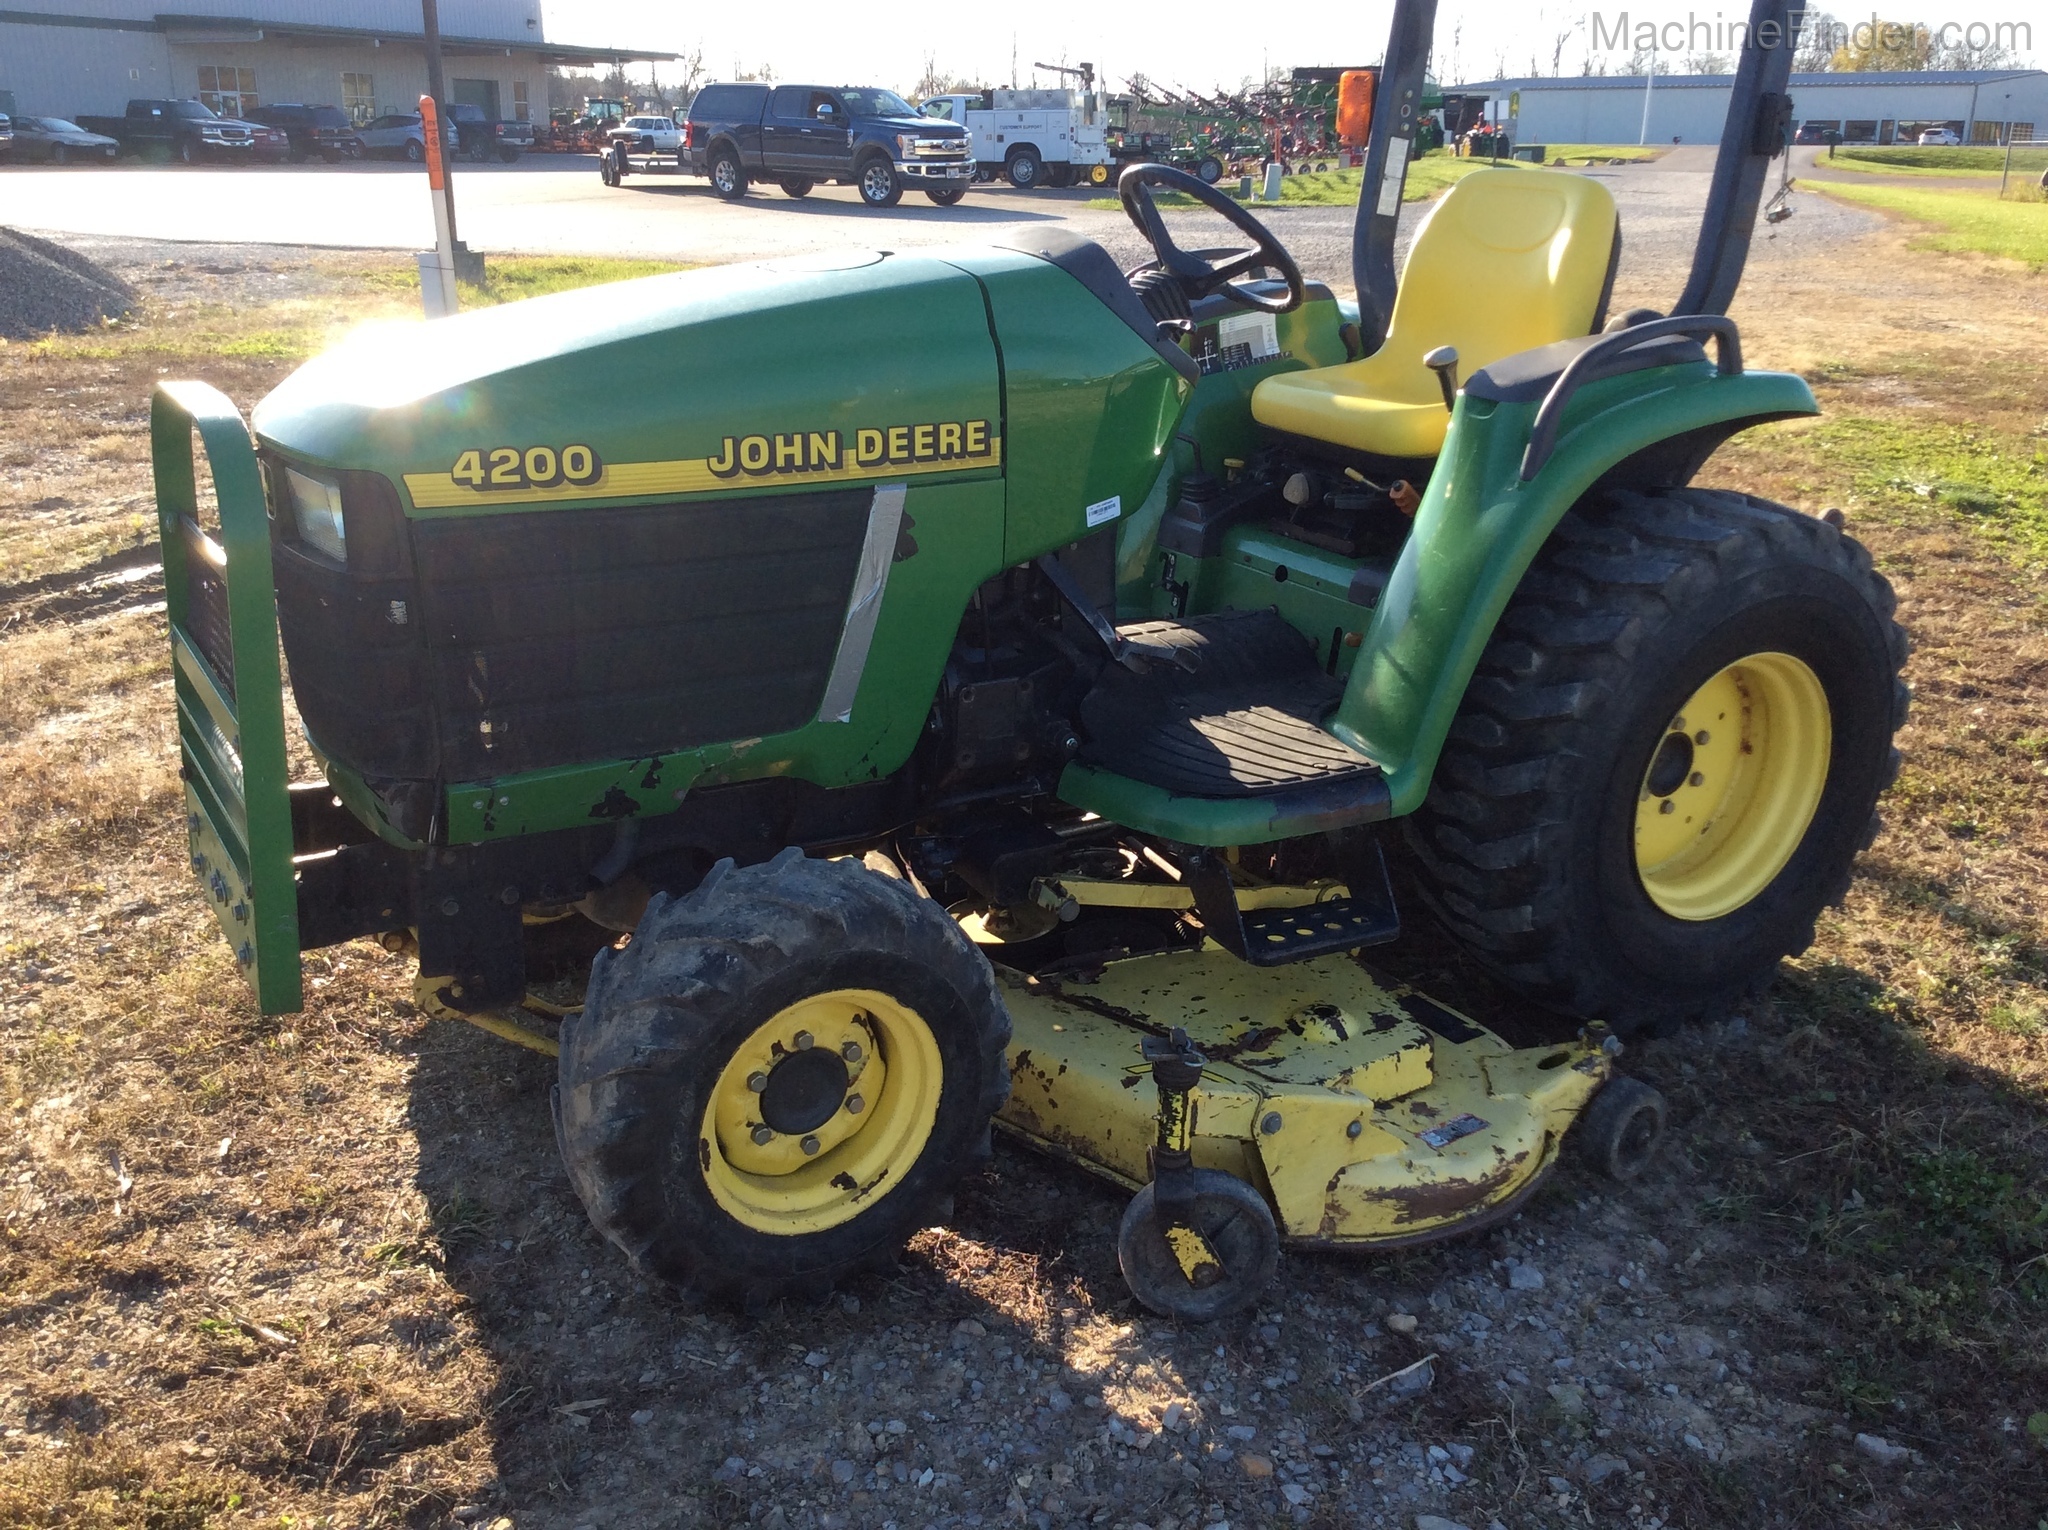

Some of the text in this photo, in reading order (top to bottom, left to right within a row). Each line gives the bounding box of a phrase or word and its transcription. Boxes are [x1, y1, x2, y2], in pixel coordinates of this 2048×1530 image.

[451, 444, 598, 489] 4200
[707, 420, 989, 476] JOHN DEERE
